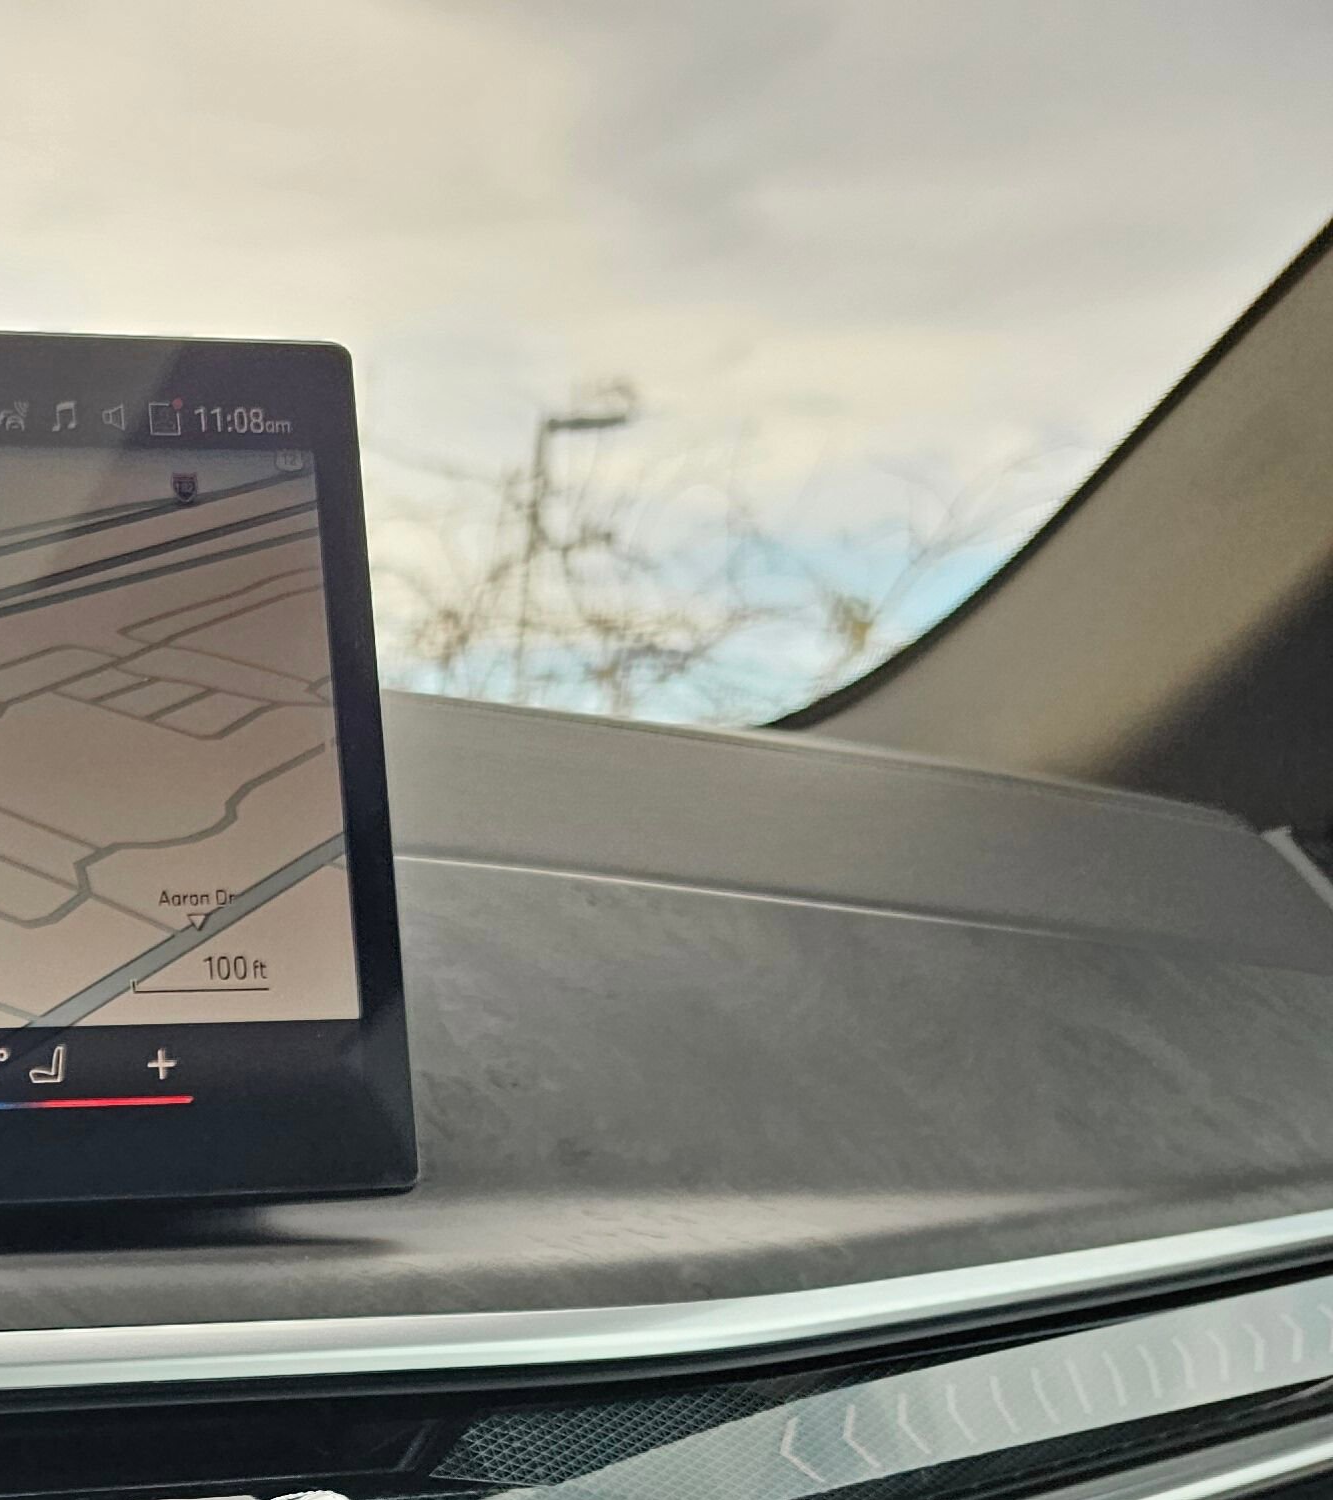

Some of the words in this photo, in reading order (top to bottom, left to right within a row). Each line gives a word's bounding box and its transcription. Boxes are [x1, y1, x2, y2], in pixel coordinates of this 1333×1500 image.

[194, 406, 291, 434] 11:08am
[158, 889, 210, 907] Aaron
[215, 889, 235, 906] Dr
[203, 954, 248, 981] 100
[252, 959, 268, 980] ft
